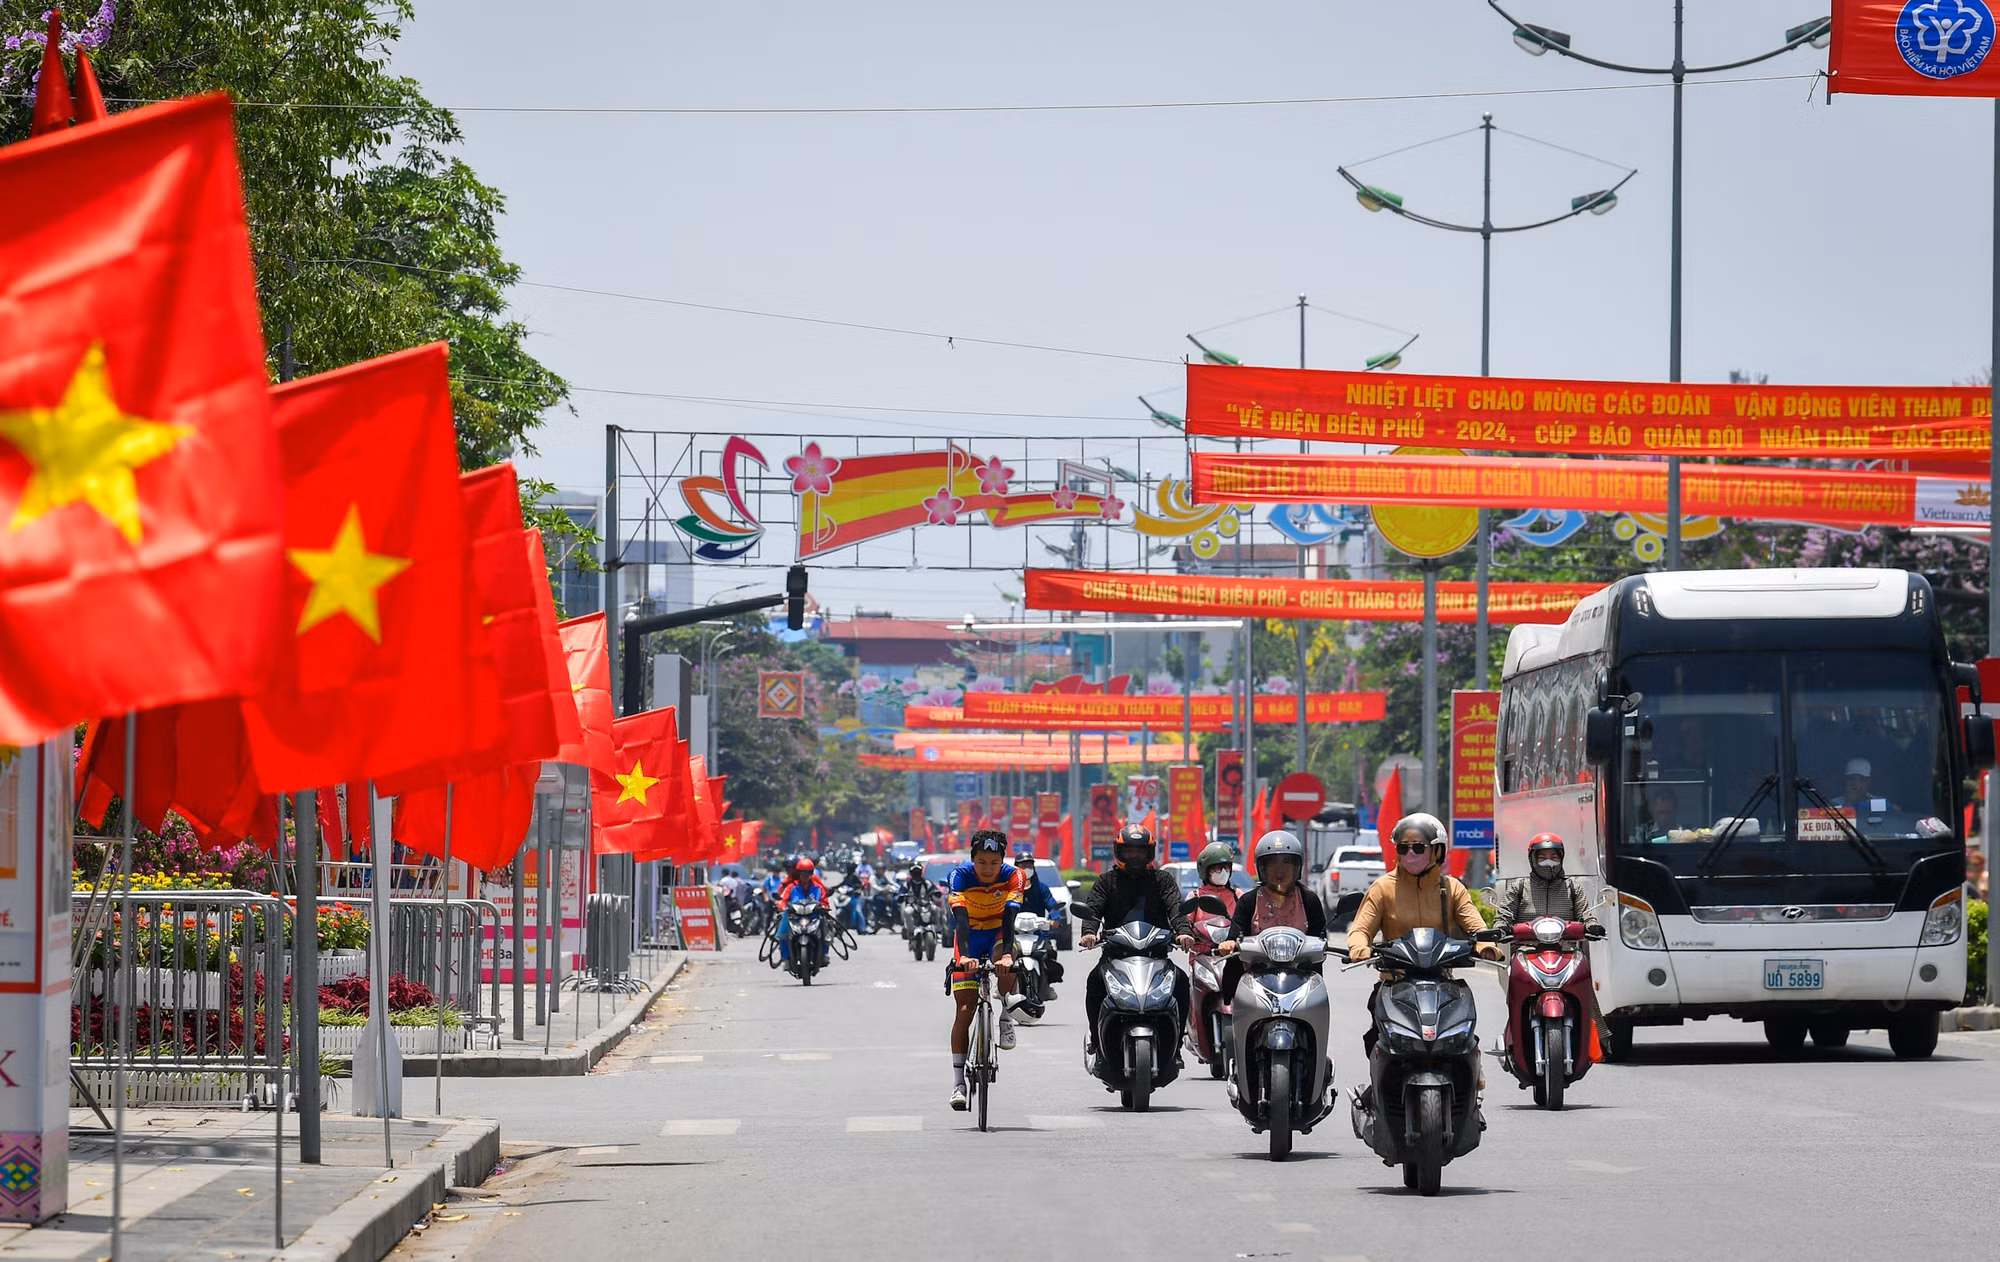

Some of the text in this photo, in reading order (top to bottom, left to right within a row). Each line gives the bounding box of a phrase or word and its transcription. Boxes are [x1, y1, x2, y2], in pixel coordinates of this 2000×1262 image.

[1899, 28, 1991, 76] BẢO HIỂM XÃ HỘI VIỆT NAM
[1347, 381, 1408, 410] NHIỆT
[1413, 382, 1457, 412] LIỆT
[1468, 386, 1525, 411] CHÀO
[1533, 387, 1596, 414] MỪNG
[1603, 388, 1646, 415] CÁC
[1652, 390, 1711, 415] ĐOÀN
[1734, 391, 1777, 420] VẬN
[1783, 391, 1841, 421] ĐỘNG
[1847, 392, 1896, 417] VIÊN
[1903, 396, 1962, 417] THAM
[1270, 408, 1320, 436] ĐIỆN
[1326, 411, 1376, 437] BIÊN
[1382, 412, 1425, 439] PHỦ
[1456, 420, 1516, 444] 2024,
[1535, 420, 1577, 444] CÚP
[1589, 421, 1632, 446] BÁO
[1643, 424, 1701, 449] QUÂN
[1707, 425, 1744, 452] ĐỘI
[1760, 425, 1819, 449] NHÂN
[1892, 425, 1933, 449] CÁC
[1213, 462, 1260, 497] NHIỆT
[1266, 461, 1299, 497] LIỆT
[1306, 461, 1350, 494] CHÀO
[1355, 462, 1406, 494] MỪNG
[1412, 468, 1431, 494] 70
[1436, 462, 1476, 495] NĂM
[1481, 462, 1532, 496] CHIẾN
[1537, 463, 1592, 498] THẮNG
[1597, 468, 1637, 505] ĐIỆN
[1642, 469, 1669, 499] BIÊ
[1686, 470, 1720, 503] PHỦ
[1083, 579, 1127, 600] CHIẾN
[1131, 580, 1178, 604] THẮNG
[1182, 584, 1216, 608] ĐIỆN
[1219, 584, 1254, 607] BIÊN
[1258, 585, 1287, 608] PHỦ
[1299, 585, 1343, 608] CHIẾN
[1347, 586, 1394, 610] THẮNG
[1803, 823, 1814, 832] XE
[1789, 972, 1820, 987] 5899
